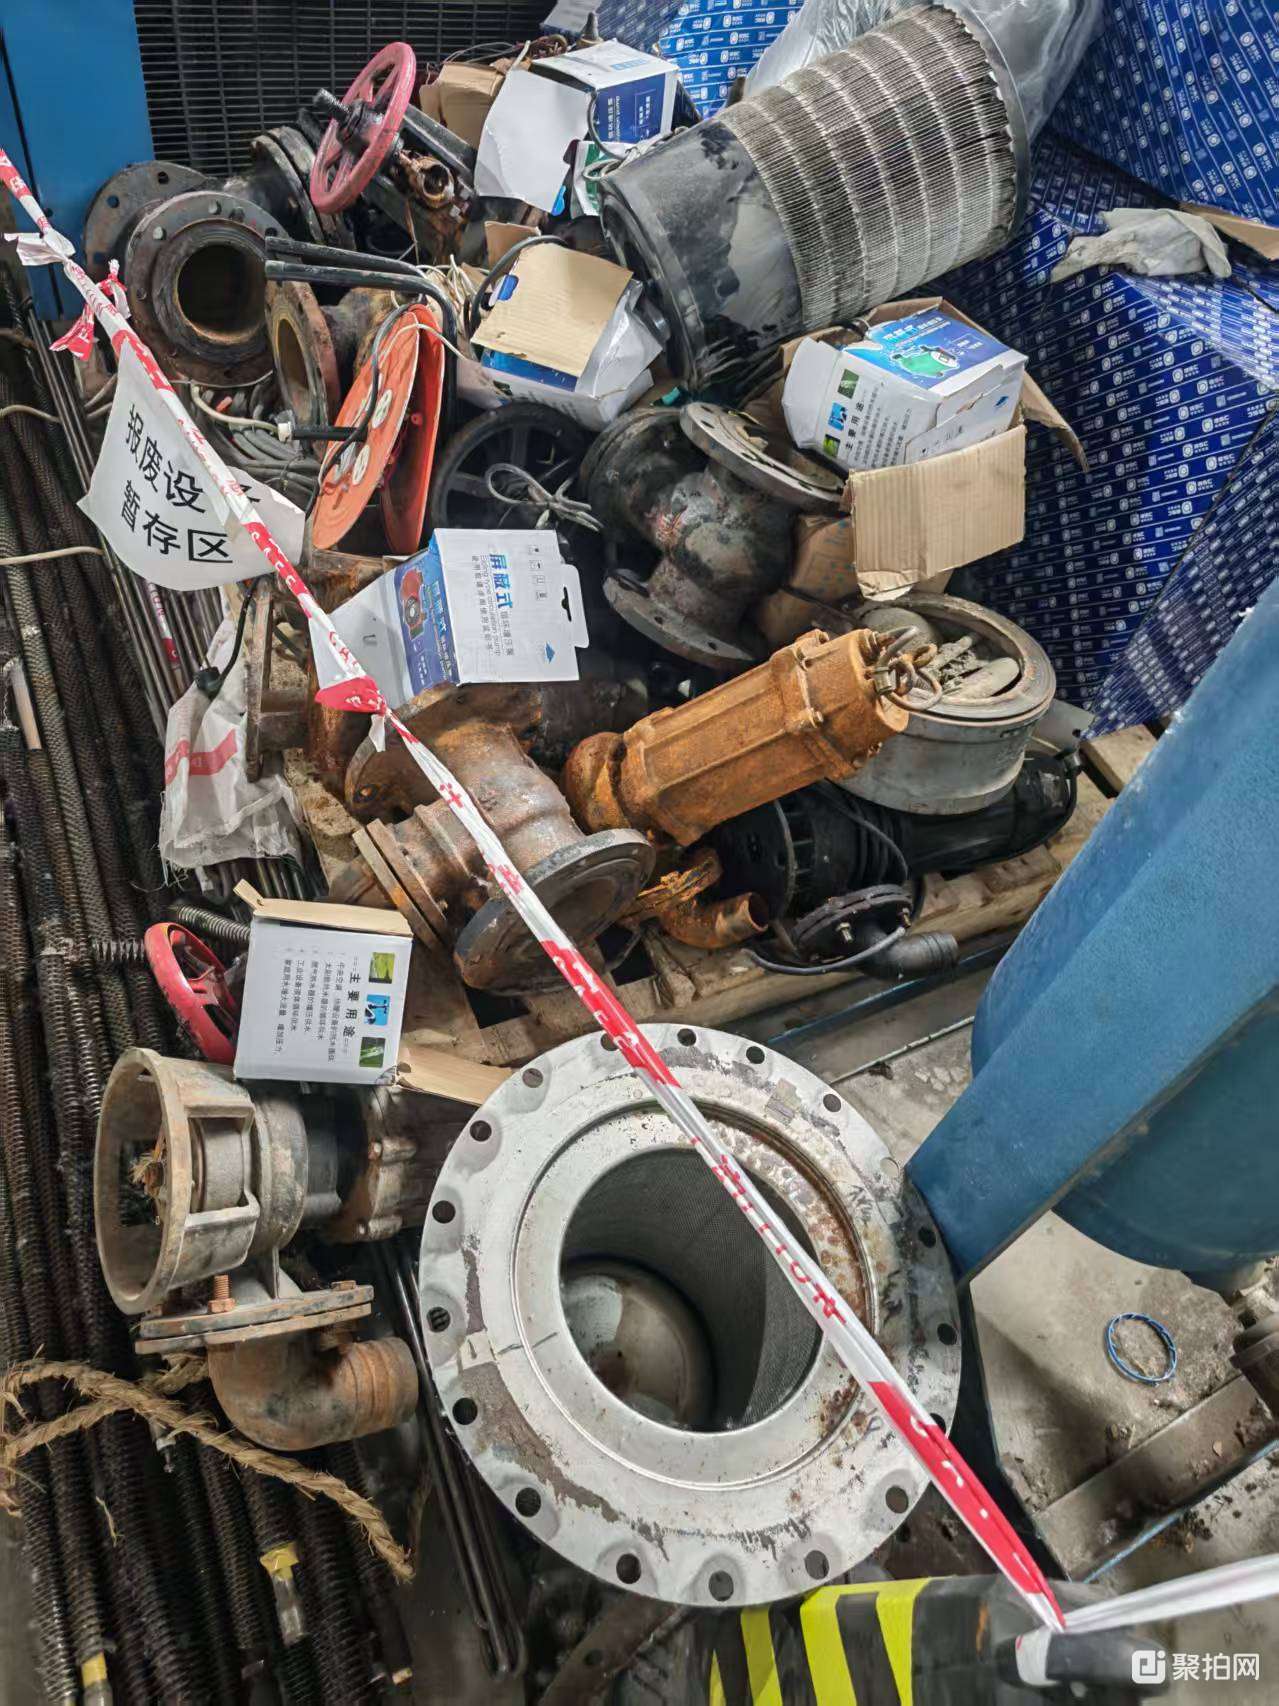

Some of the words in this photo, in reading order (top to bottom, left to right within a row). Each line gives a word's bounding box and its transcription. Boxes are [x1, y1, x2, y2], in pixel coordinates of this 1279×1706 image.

[120, 479, 233, 564] 暂存区
[343, 972, 361, 1038] 主要用途
